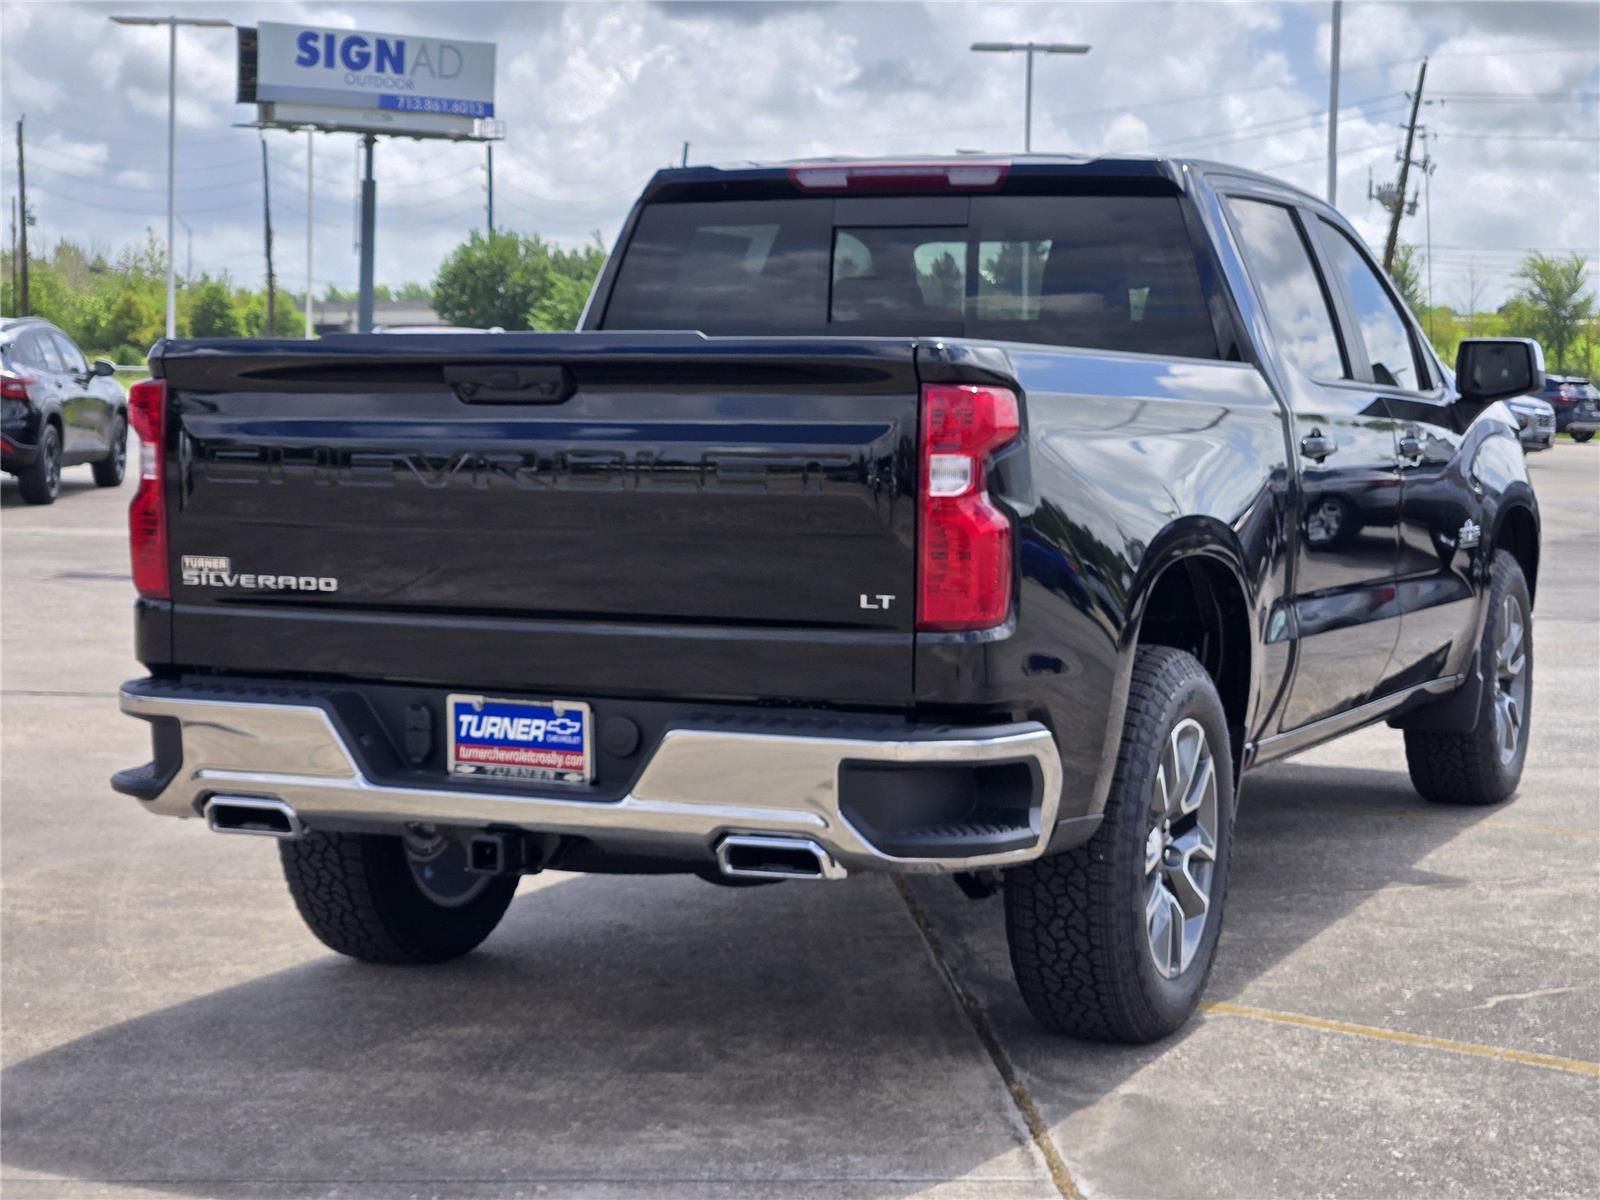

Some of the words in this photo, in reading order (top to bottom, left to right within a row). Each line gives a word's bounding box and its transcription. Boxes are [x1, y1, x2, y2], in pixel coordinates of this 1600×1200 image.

[344, 74, 415, 90] OUTDOOR
[204, 448, 852, 495] CHEVROLET
[183, 556, 227, 570] TURNER
[182, 570, 339, 592] SILVERADO
[860, 594, 896, 609] LT
[459, 714, 547, 742] TURNER
